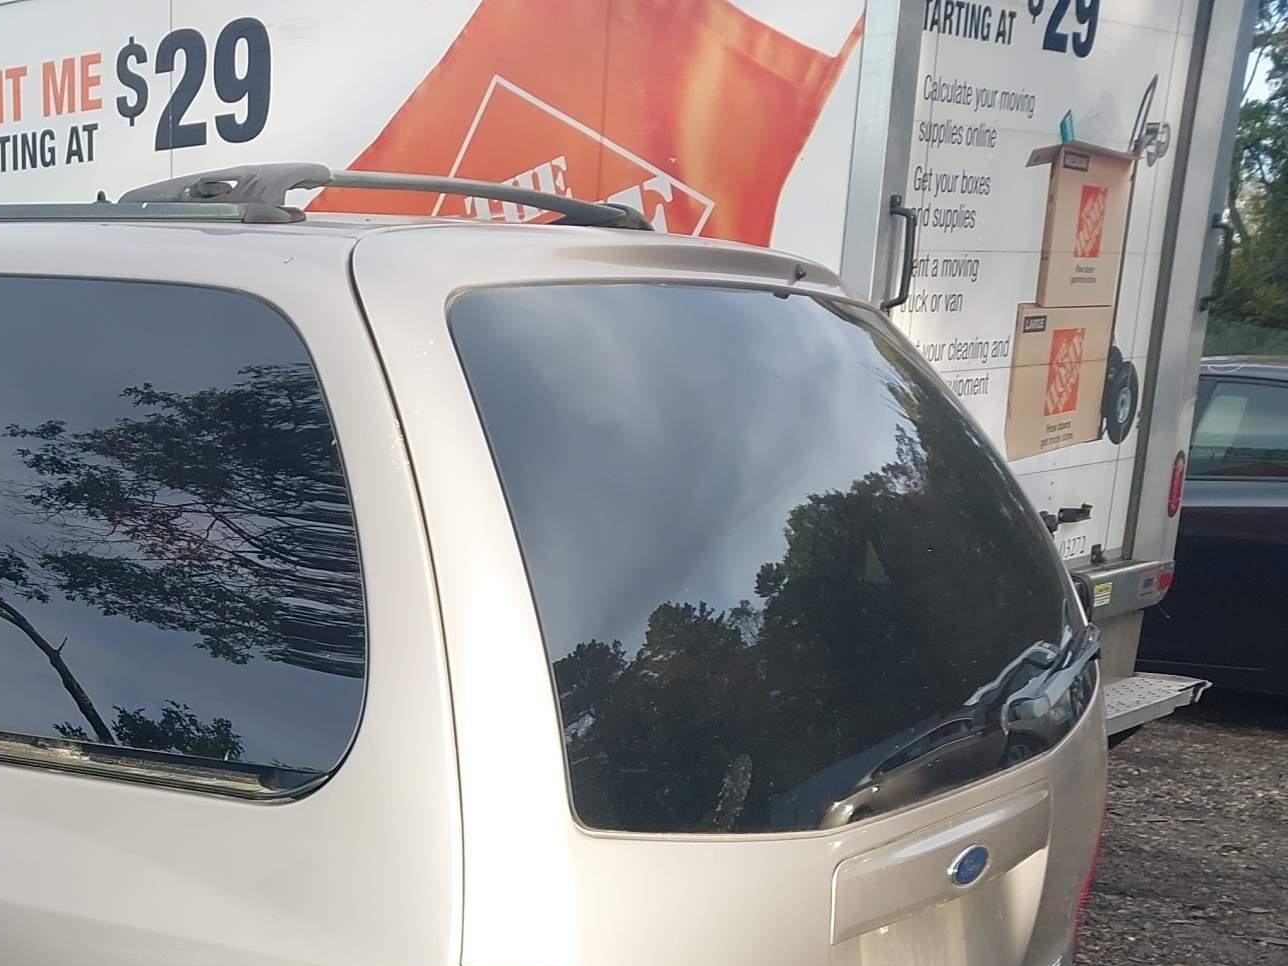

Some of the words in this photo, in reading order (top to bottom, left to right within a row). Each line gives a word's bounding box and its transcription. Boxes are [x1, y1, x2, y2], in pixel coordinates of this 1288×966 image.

[923, 0, 992, 42] TARTING
[995, 9, 1017, 45] AT
[42, 53, 103, 118] ME
[116, 17, 271, 151] $29
[923, 75, 973, 106] Calculate
[974, 87, 998, 112] your
[1000, 89, 1036, 119] moving
[65, 123, 99, 165] AT
[918, 119, 963, 149] supplies
[965, 123, 997, 149] online
[913, 166, 933, 192] Get
[934, 173, 959, 198] your
[960, 170, 991, 196] boxes
[932, 204, 976, 234] supplies
[912, 254, 929, 278] ent
[931, 258, 938, 277] a
[941, 254, 979, 283] moving
[930, 294, 941, 312] or
[945, 293, 963, 312] van
[947, 337, 988, 364] cleaning
[991, 336, 1011, 358] and
[947, 373, 989, 397] uipment
